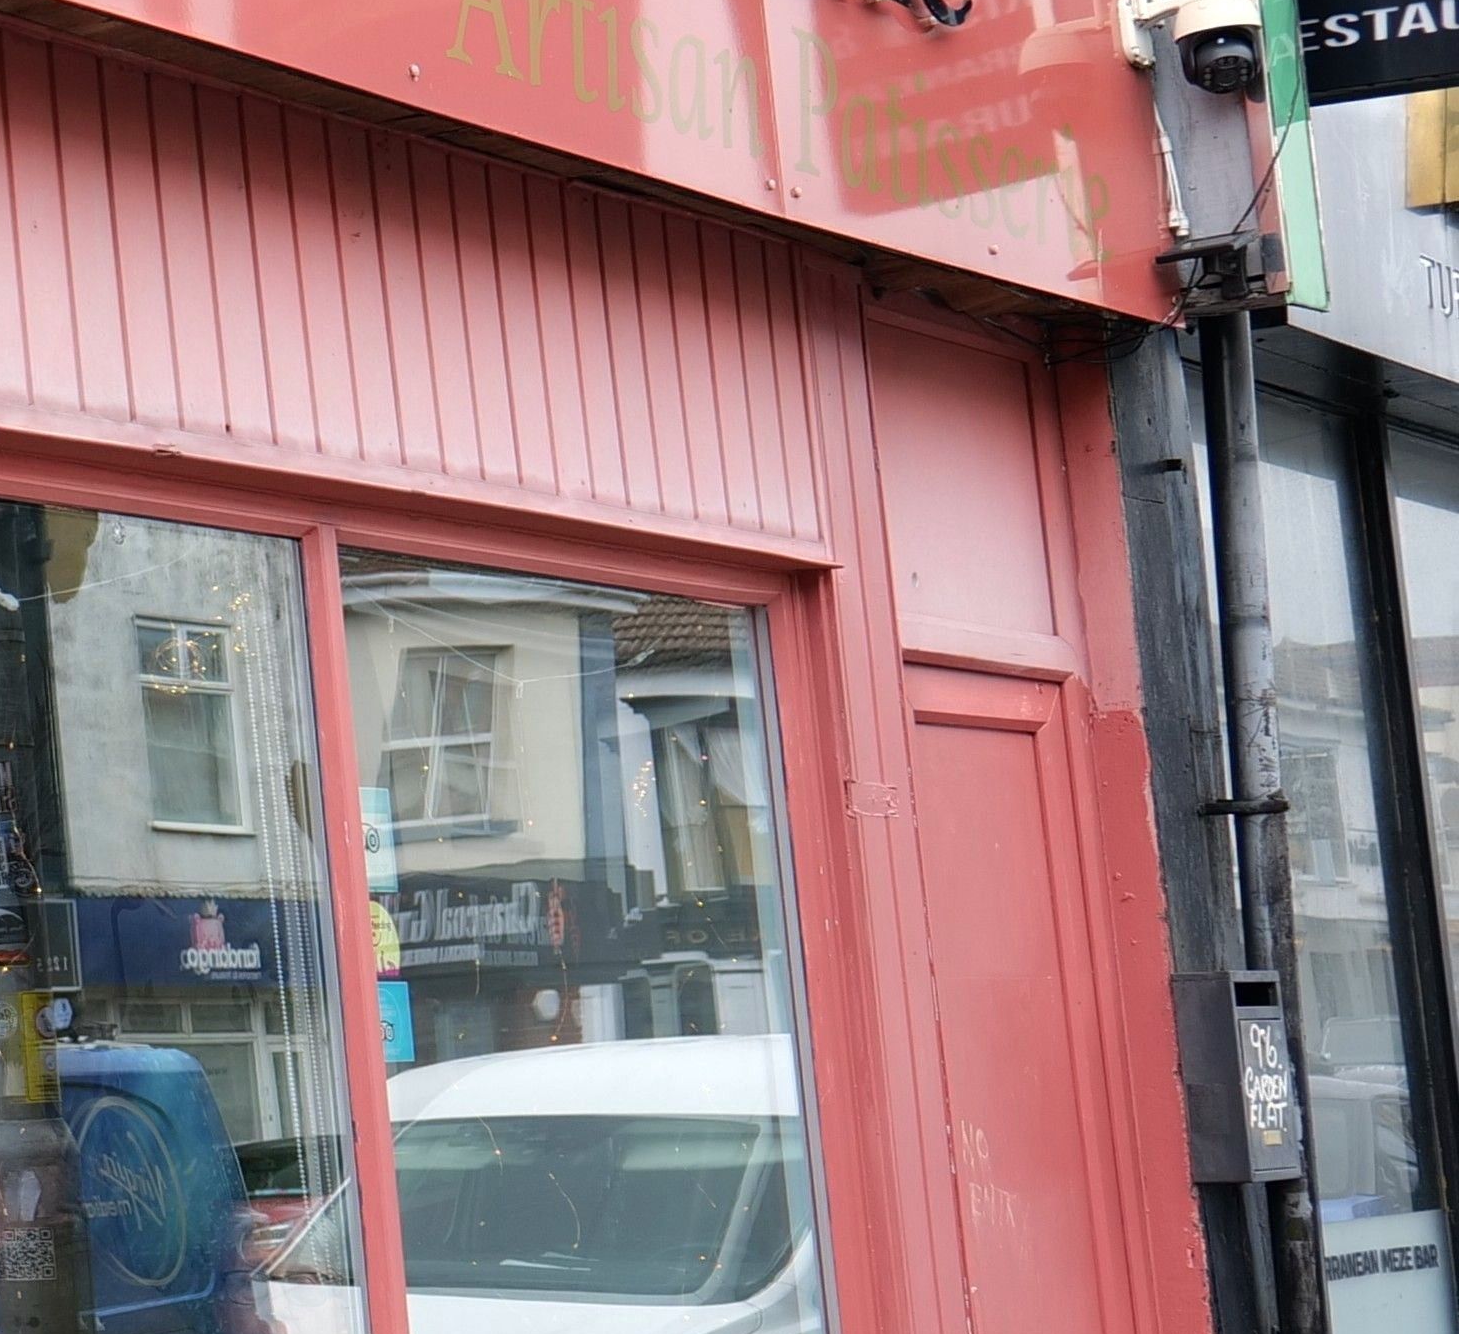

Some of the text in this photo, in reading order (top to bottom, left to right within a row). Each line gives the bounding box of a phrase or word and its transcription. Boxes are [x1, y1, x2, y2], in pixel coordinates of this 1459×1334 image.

[791, 26, 1116, 263] Patisserie
[1244, 1068, 1288, 1102] GARDEN
[1380, 1246, 1413, 1274] MEZE
[1413, 1243, 1439, 1270] BAR
